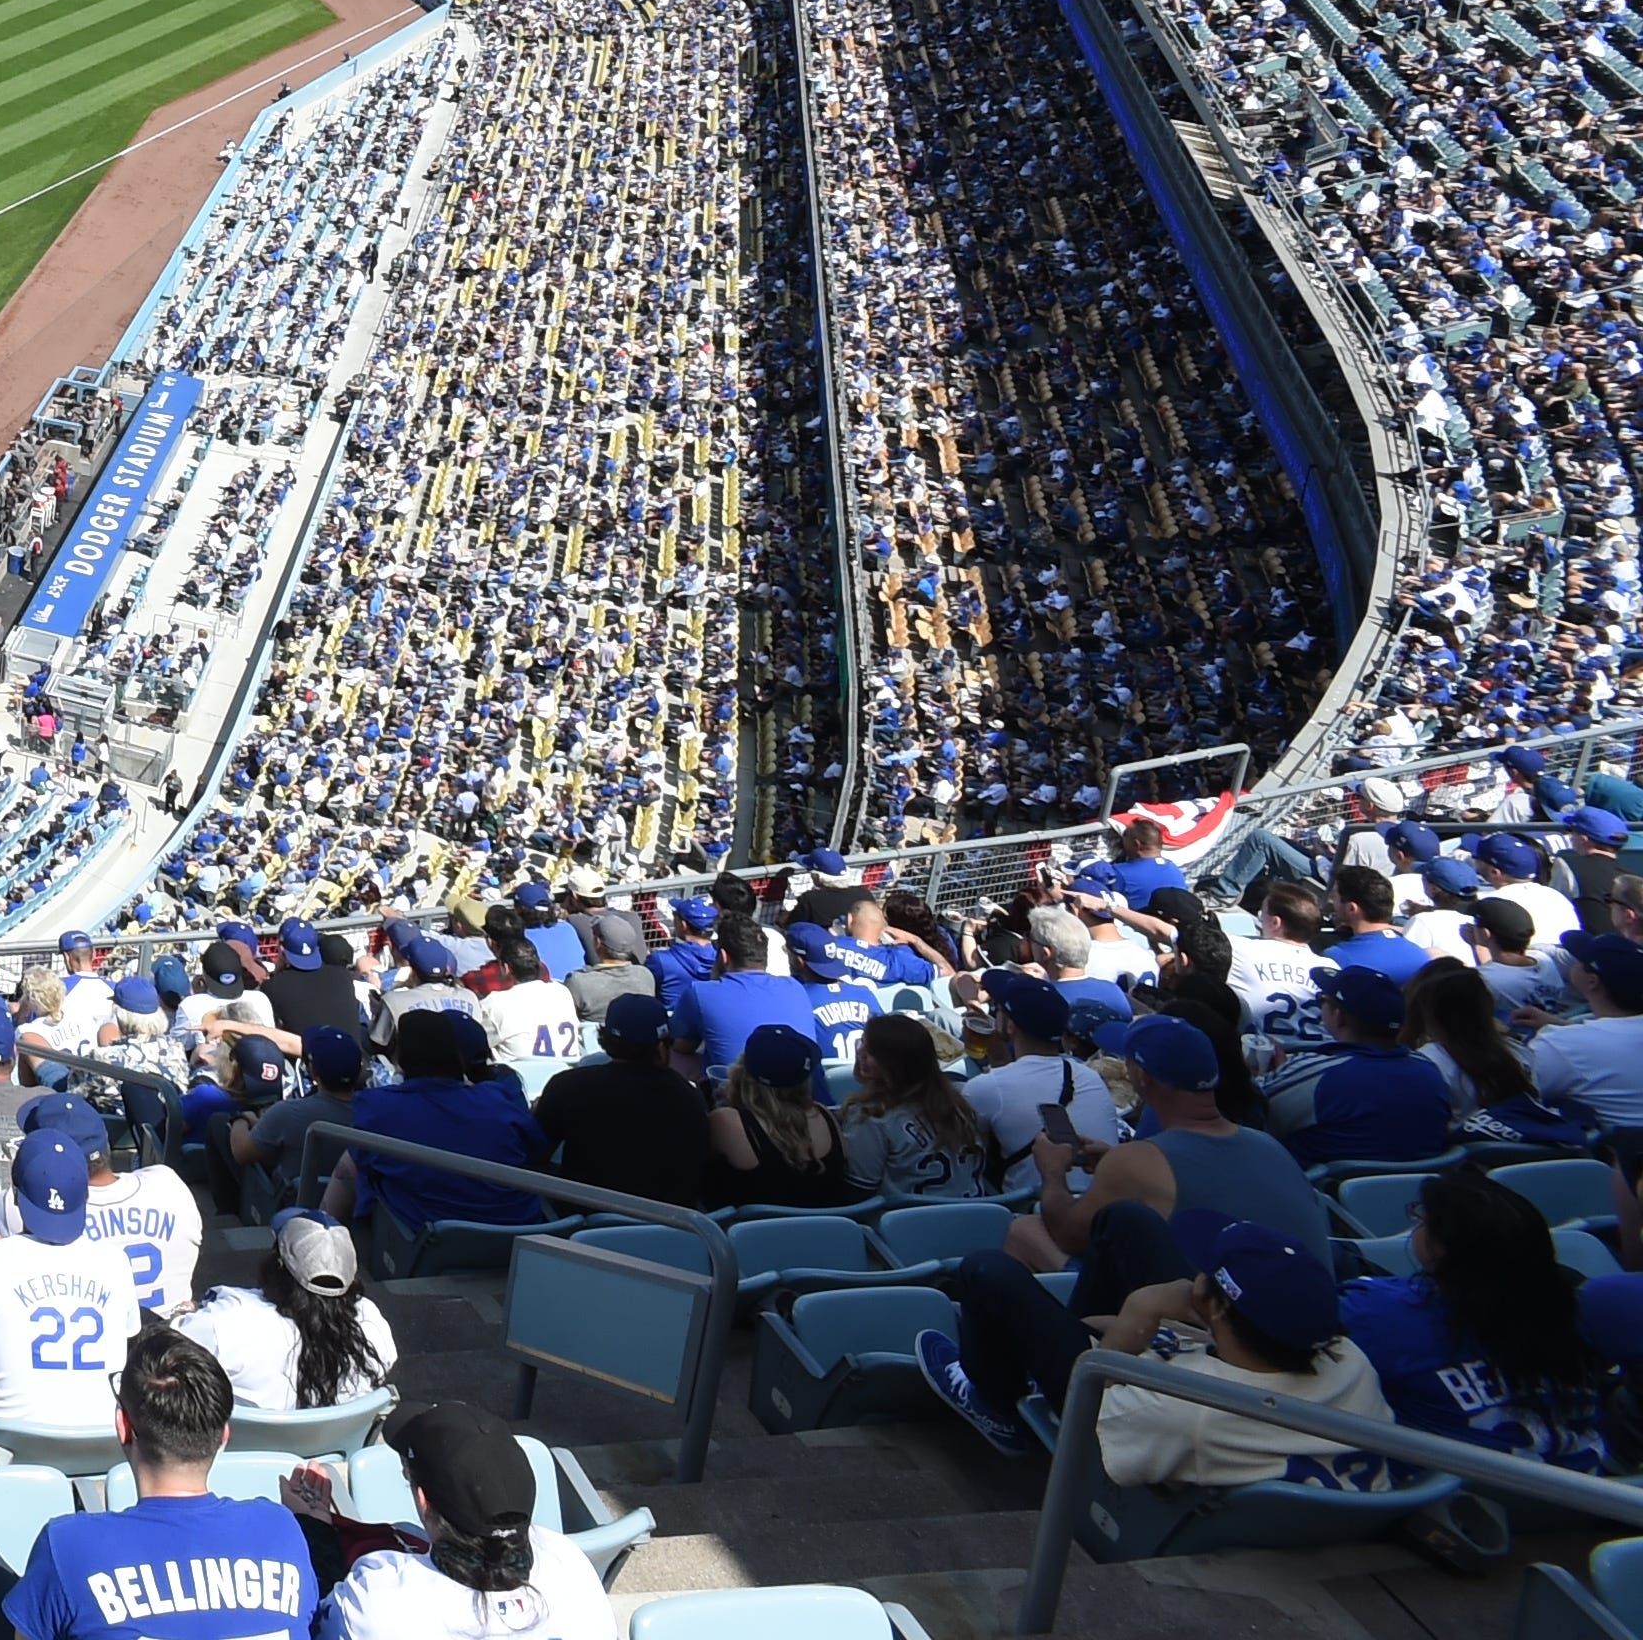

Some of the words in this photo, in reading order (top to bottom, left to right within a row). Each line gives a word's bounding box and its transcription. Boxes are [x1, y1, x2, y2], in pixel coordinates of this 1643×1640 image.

[66, 495, 129, 574] DODGER
[114, 413, 170, 487] STADIUM
[813, 1001, 870, 1028] TURNER
[50, 1021, 84, 1047] UTLEY
[533, 1021, 577, 1058] 42
[47, 1187, 65, 1211] LA
[82, 1206, 176, 1243] BINSON
[13, 1272, 112, 1309] KERSHAW
[123, 1242, 165, 1309] 2
[29, 1306, 106, 1371] 22
[87, 1557, 302, 1627] BELLINGER
